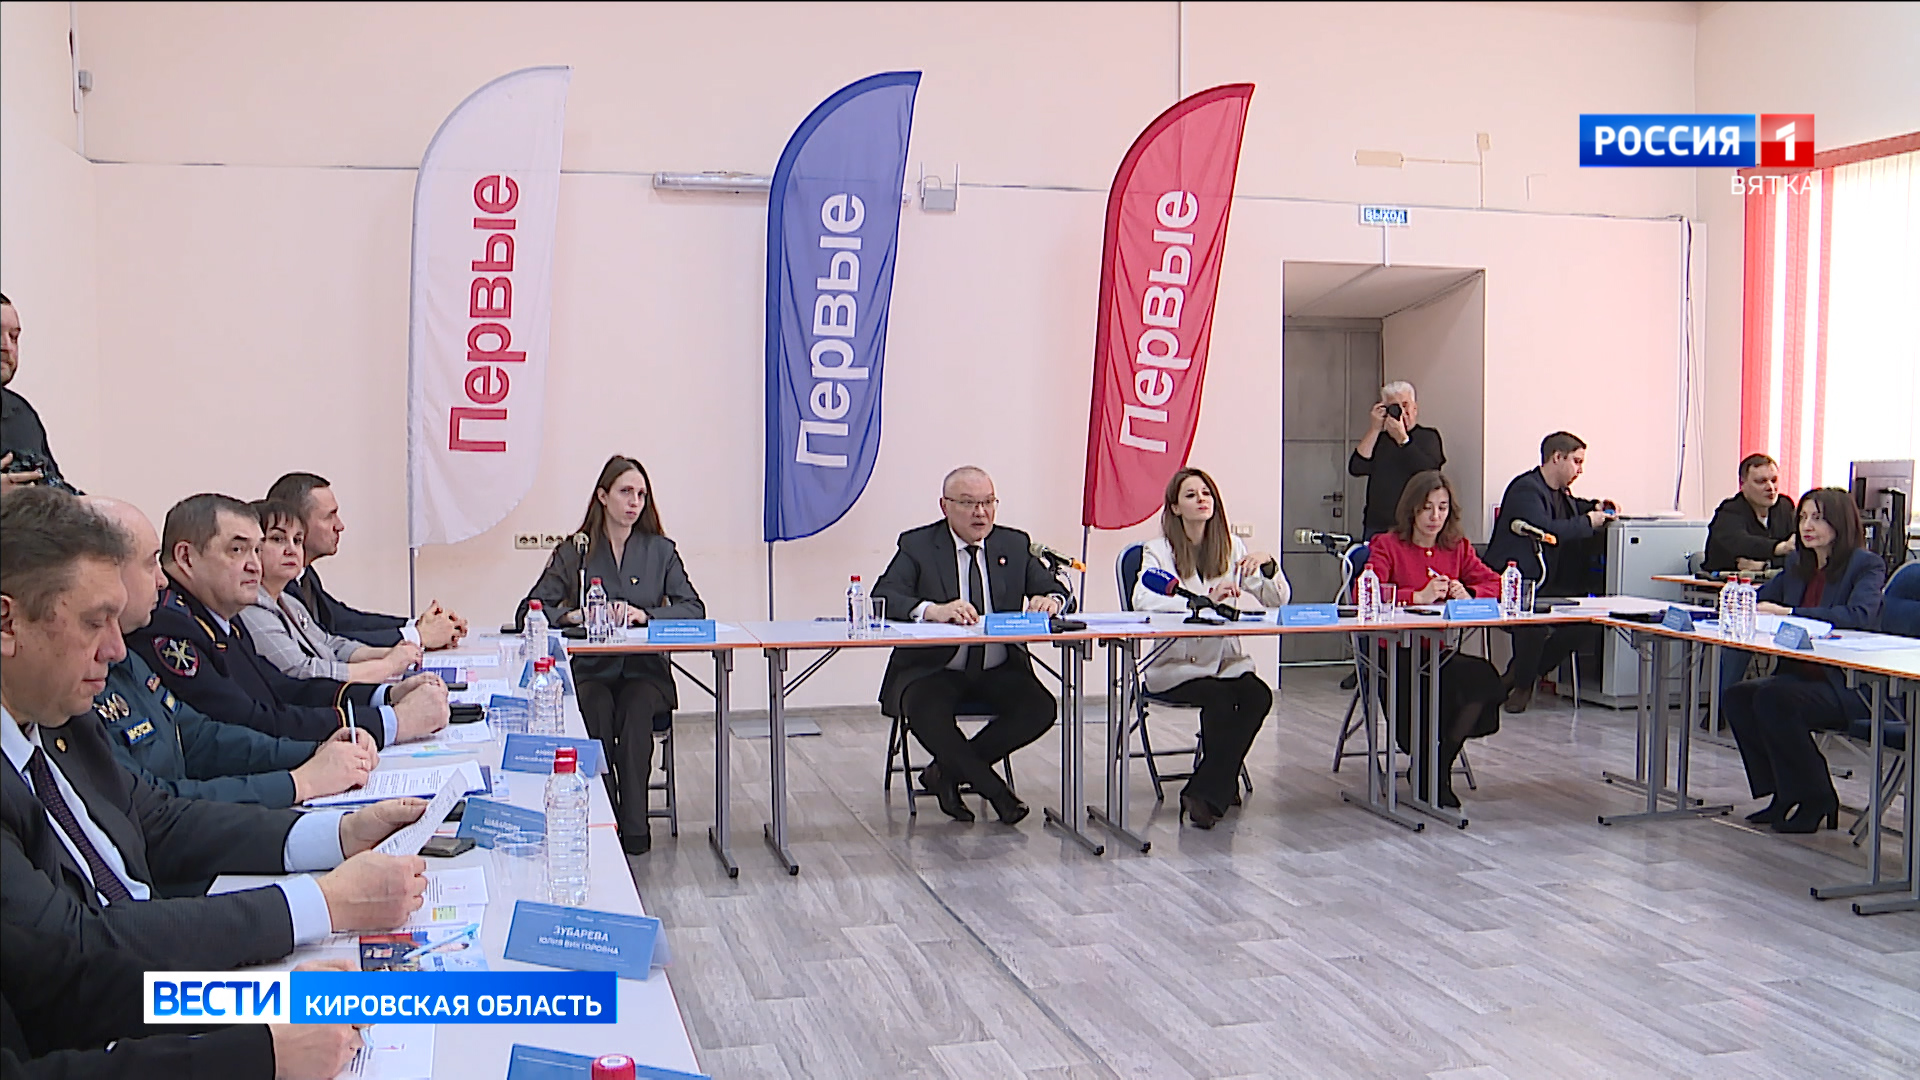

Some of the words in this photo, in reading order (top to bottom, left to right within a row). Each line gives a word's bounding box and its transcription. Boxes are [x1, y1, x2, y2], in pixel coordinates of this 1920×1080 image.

[448, 174, 527, 453] Первые
[795, 193, 870, 468] Первые
[1118, 190, 1199, 453] Первые
[1364, 208, 1406, 223] ВЫХОД
[553, 925, 610, 941] ЗУБАРЕВА
